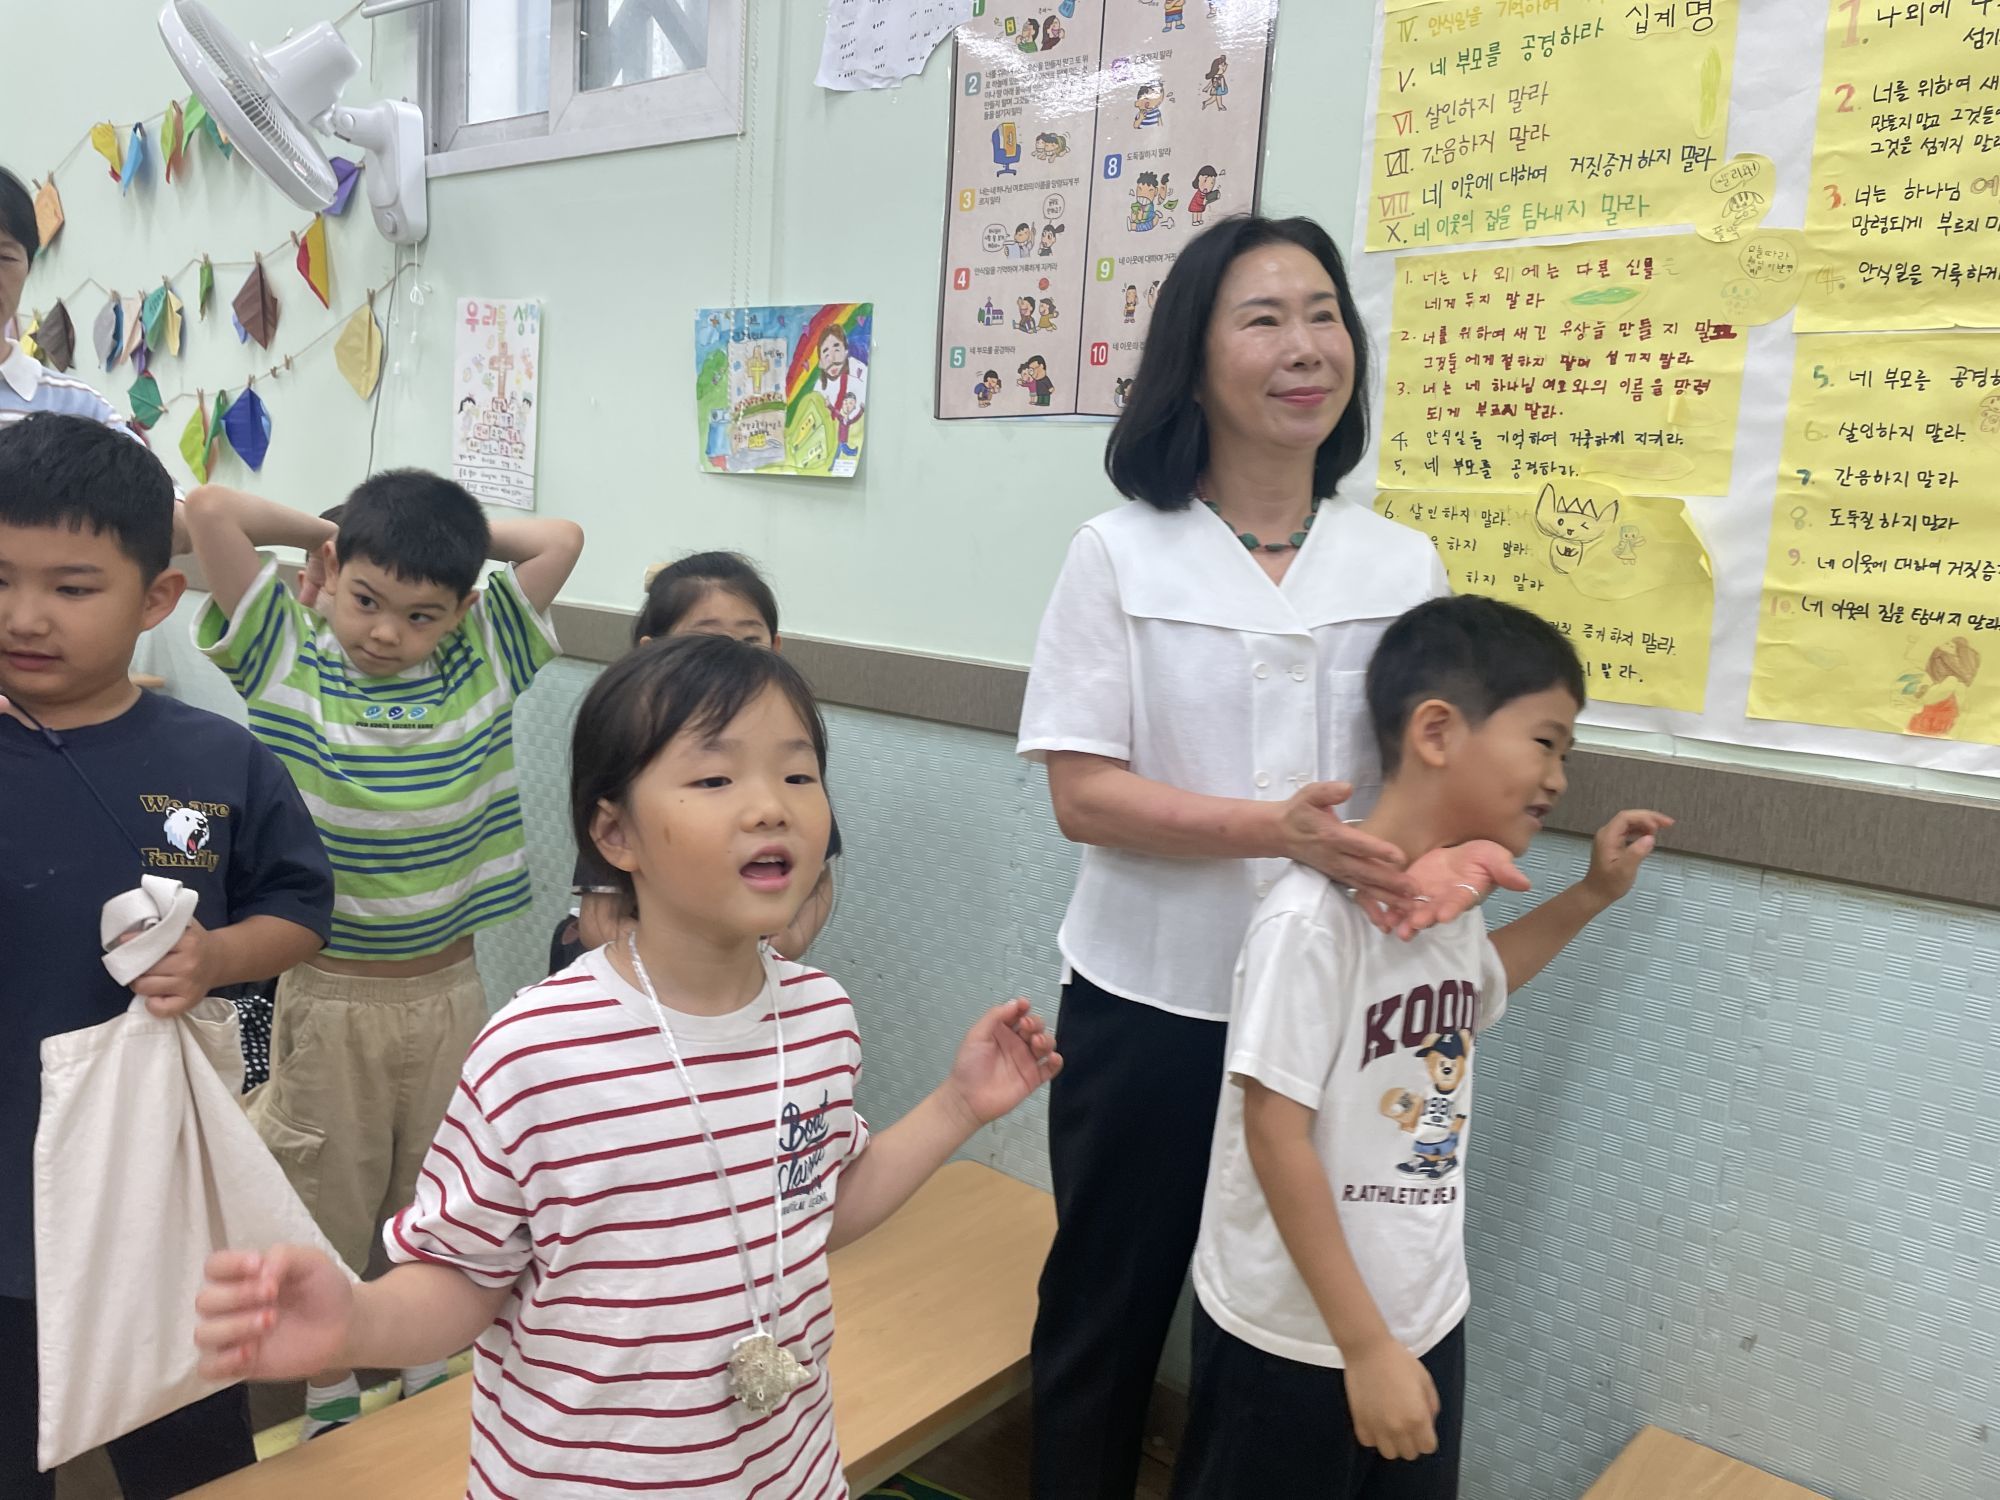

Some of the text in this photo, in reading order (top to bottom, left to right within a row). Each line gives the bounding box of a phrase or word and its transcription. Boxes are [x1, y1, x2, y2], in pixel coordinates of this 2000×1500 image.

[1430, 57, 1447, 76] 네
[1456, 41, 1501, 75] 부모를
[967, 75, 978, 94] 2
[1873, 80, 1909, 104] 너를
[1918, 75, 1971, 98] 위하여
[1425, 93, 1495, 130] 살인하지
[1508, 81, 1549, 114] 말라
[1871, 112, 1941, 132] 만들지 말고
[1422, 130, 1495, 165] 간음하지
[1509, 123, 1551, 152] 말라
[1870, 135, 1964, 158] 그것을 섬기지
[1107, 157, 1118, 177] 8
[1158, 147, 1172, 157] 말라
[1422, 180, 1443, 208] 네
[1452, 173, 1493, 199] 이웃에
[1499, 164, 1547, 186] 대하여
[1681, 145, 1717, 174] 말라
[962, 192, 972, 209] 3
[1855, 185, 1887, 207] 너는
[1904, 178, 1961, 202] 하나님
[1414, 218, 1430, 241] 네
[1437, 210, 1474, 235] 이웃의
[1486, 204, 1511, 231] 집을
[1601, 193, 1650, 226] 말라
[1852, 214, 1923, 236] 망령되게
[1937, 211, 1979, 236] 부르지
[957, 271, 967, 287] 4
[1100, 260, 1111, 278] 9
[1423, 269, 1451, 286] 너는
[1463, 268, 1478, 282] 나
[1858, 261, 1923, 286] 안식일을
[1424, 297, 1456, 310] 네게
[1459, 325, 1506, 341] 위하여
[953, 349, 962, 366] 5
[1092, 345, 1107, 363] 10
[1659, 350, 1695, 370] 말라
[1491, 377, 1536, 394] 하나님
[1849, 370, 1873, 388] 네
[1884, 367, 1931, 391] 부모를
[1426, 429, 1483, 450] 안식일을
[1497, 429, 1557, 450] 기억하여
[1838, 421, 1914, 443] 살인하지
[1424, 456, 1439, 477] 네
[1453, 457, 1493, 480] 부모를
[1917, 470, 1959, 489] 말라
[1410, 503, 1470, 524] 살인하지
[1817, 556, 1835, 570] 네
[1842, 550, 1887, 574] 이웃에
[1894, 558, 1941, 575] 대하여
[1513, 573, 1545, 592] 말라
[1801, 595, 1823, 618] 네
[1831, 599, 1870, 621] 이웃의
[1878, 602, 1905, 624] 집을
